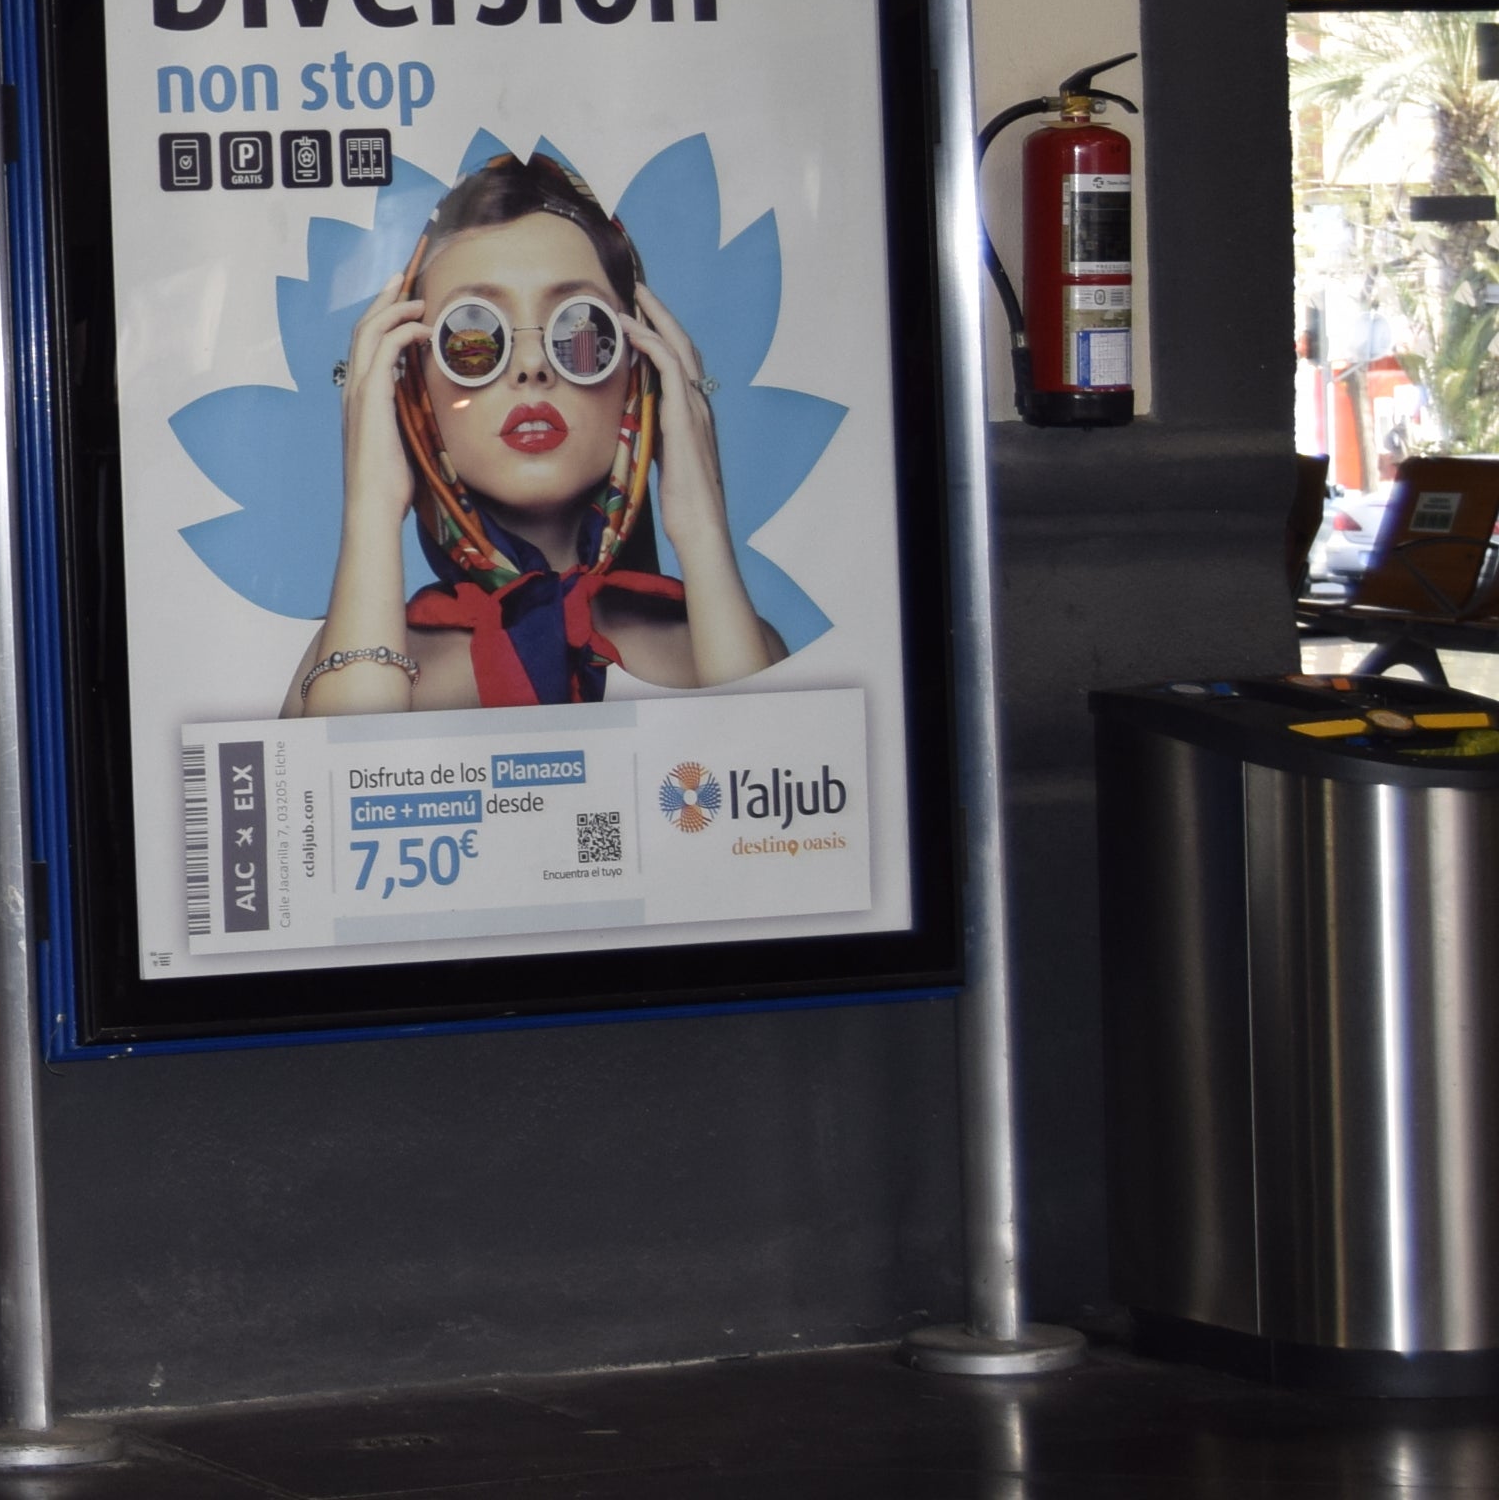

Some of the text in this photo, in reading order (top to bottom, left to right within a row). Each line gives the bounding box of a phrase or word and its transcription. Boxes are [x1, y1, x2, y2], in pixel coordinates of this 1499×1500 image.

[158, 51, 435, 126] non stop
[231, 174, 263, 185] GRATIS
[349, 759, 582, 789] Disfruta de los Planazos
[355, 801, 396, 822] cine
[418, 795, 476, 819] menú
[486, 792, 544, 814] desde
[232, 764, 256, 911] ALC ELX
[274, 741, 291, 928] Calle Jacarilla 7, 03205 Elche
[302, 790, 318, 877] cclaljub.com
[803, 832, 846, 851] oasis
[543, 866, 623, 881] Encuentra el tuyo
